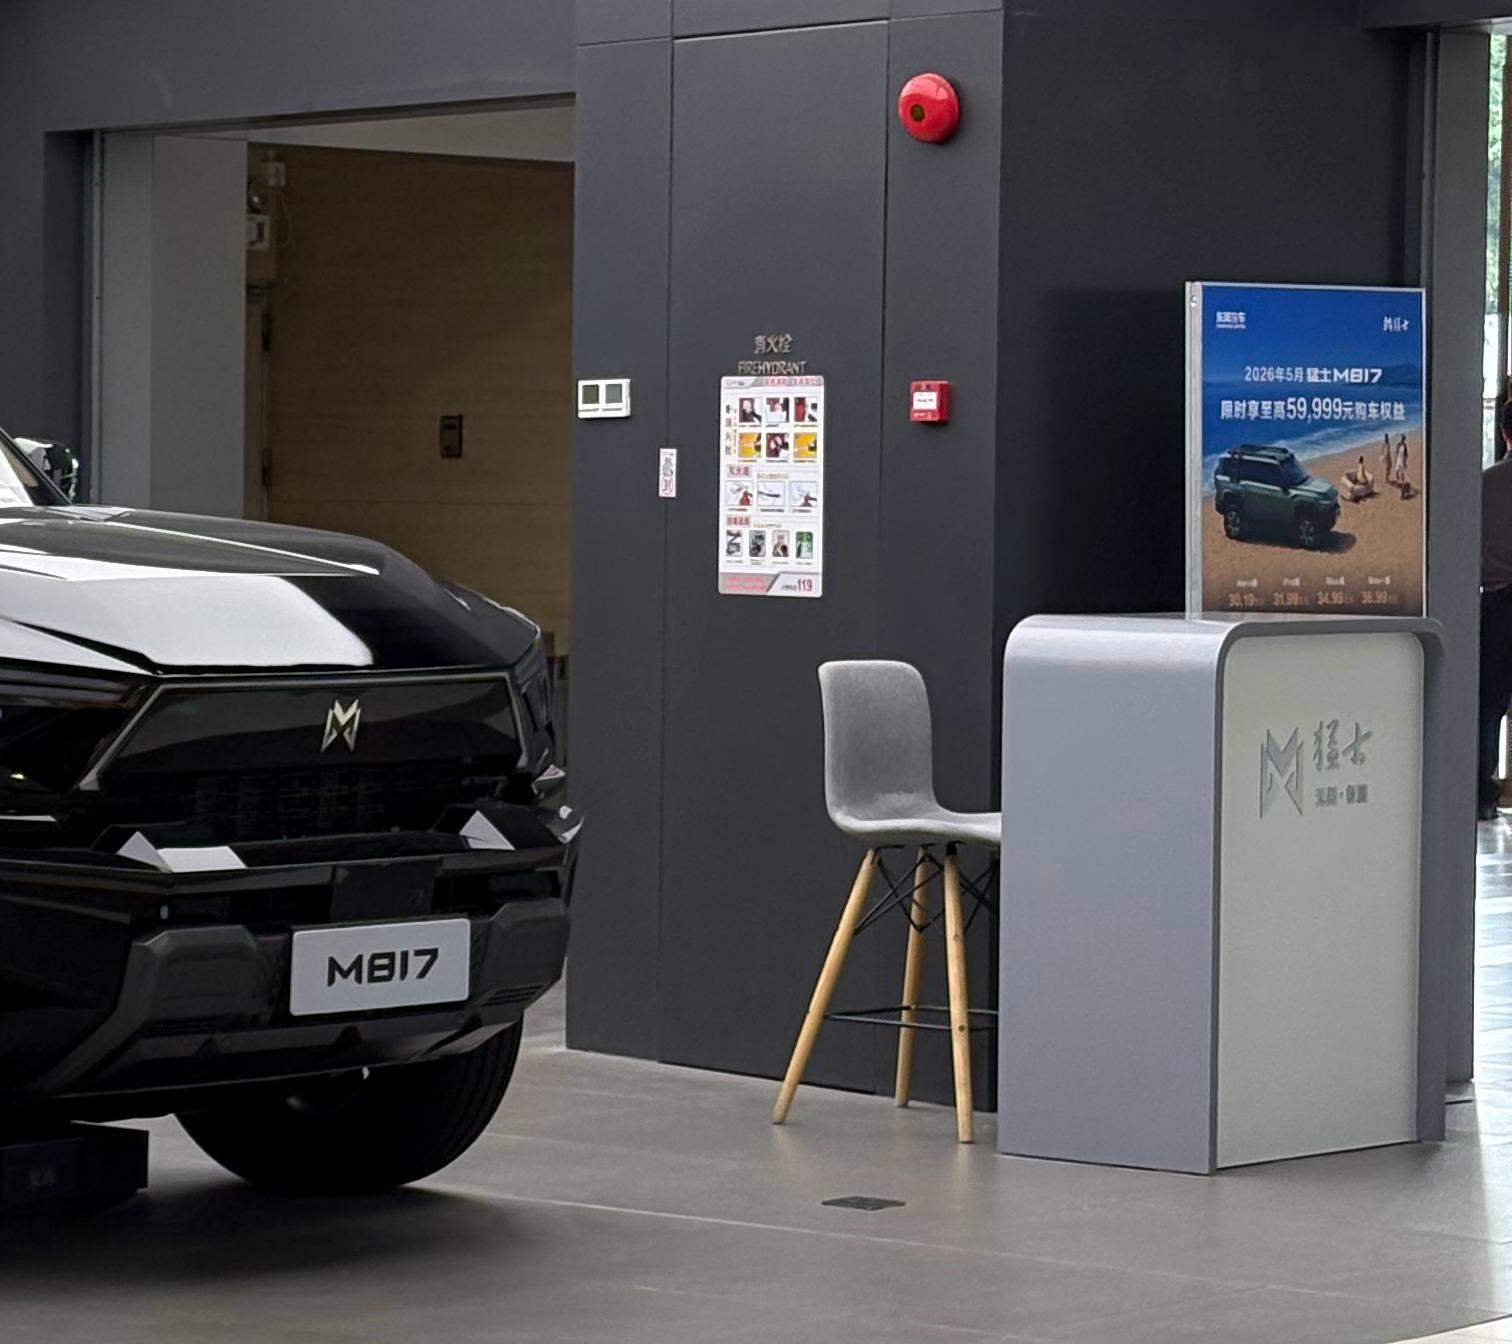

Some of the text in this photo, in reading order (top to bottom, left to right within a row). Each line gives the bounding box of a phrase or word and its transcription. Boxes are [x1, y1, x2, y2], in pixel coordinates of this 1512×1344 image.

[1221, 397, 1405, 423] 限时享至高59,999元购车权益
[327, 947, 439, 988] M817
